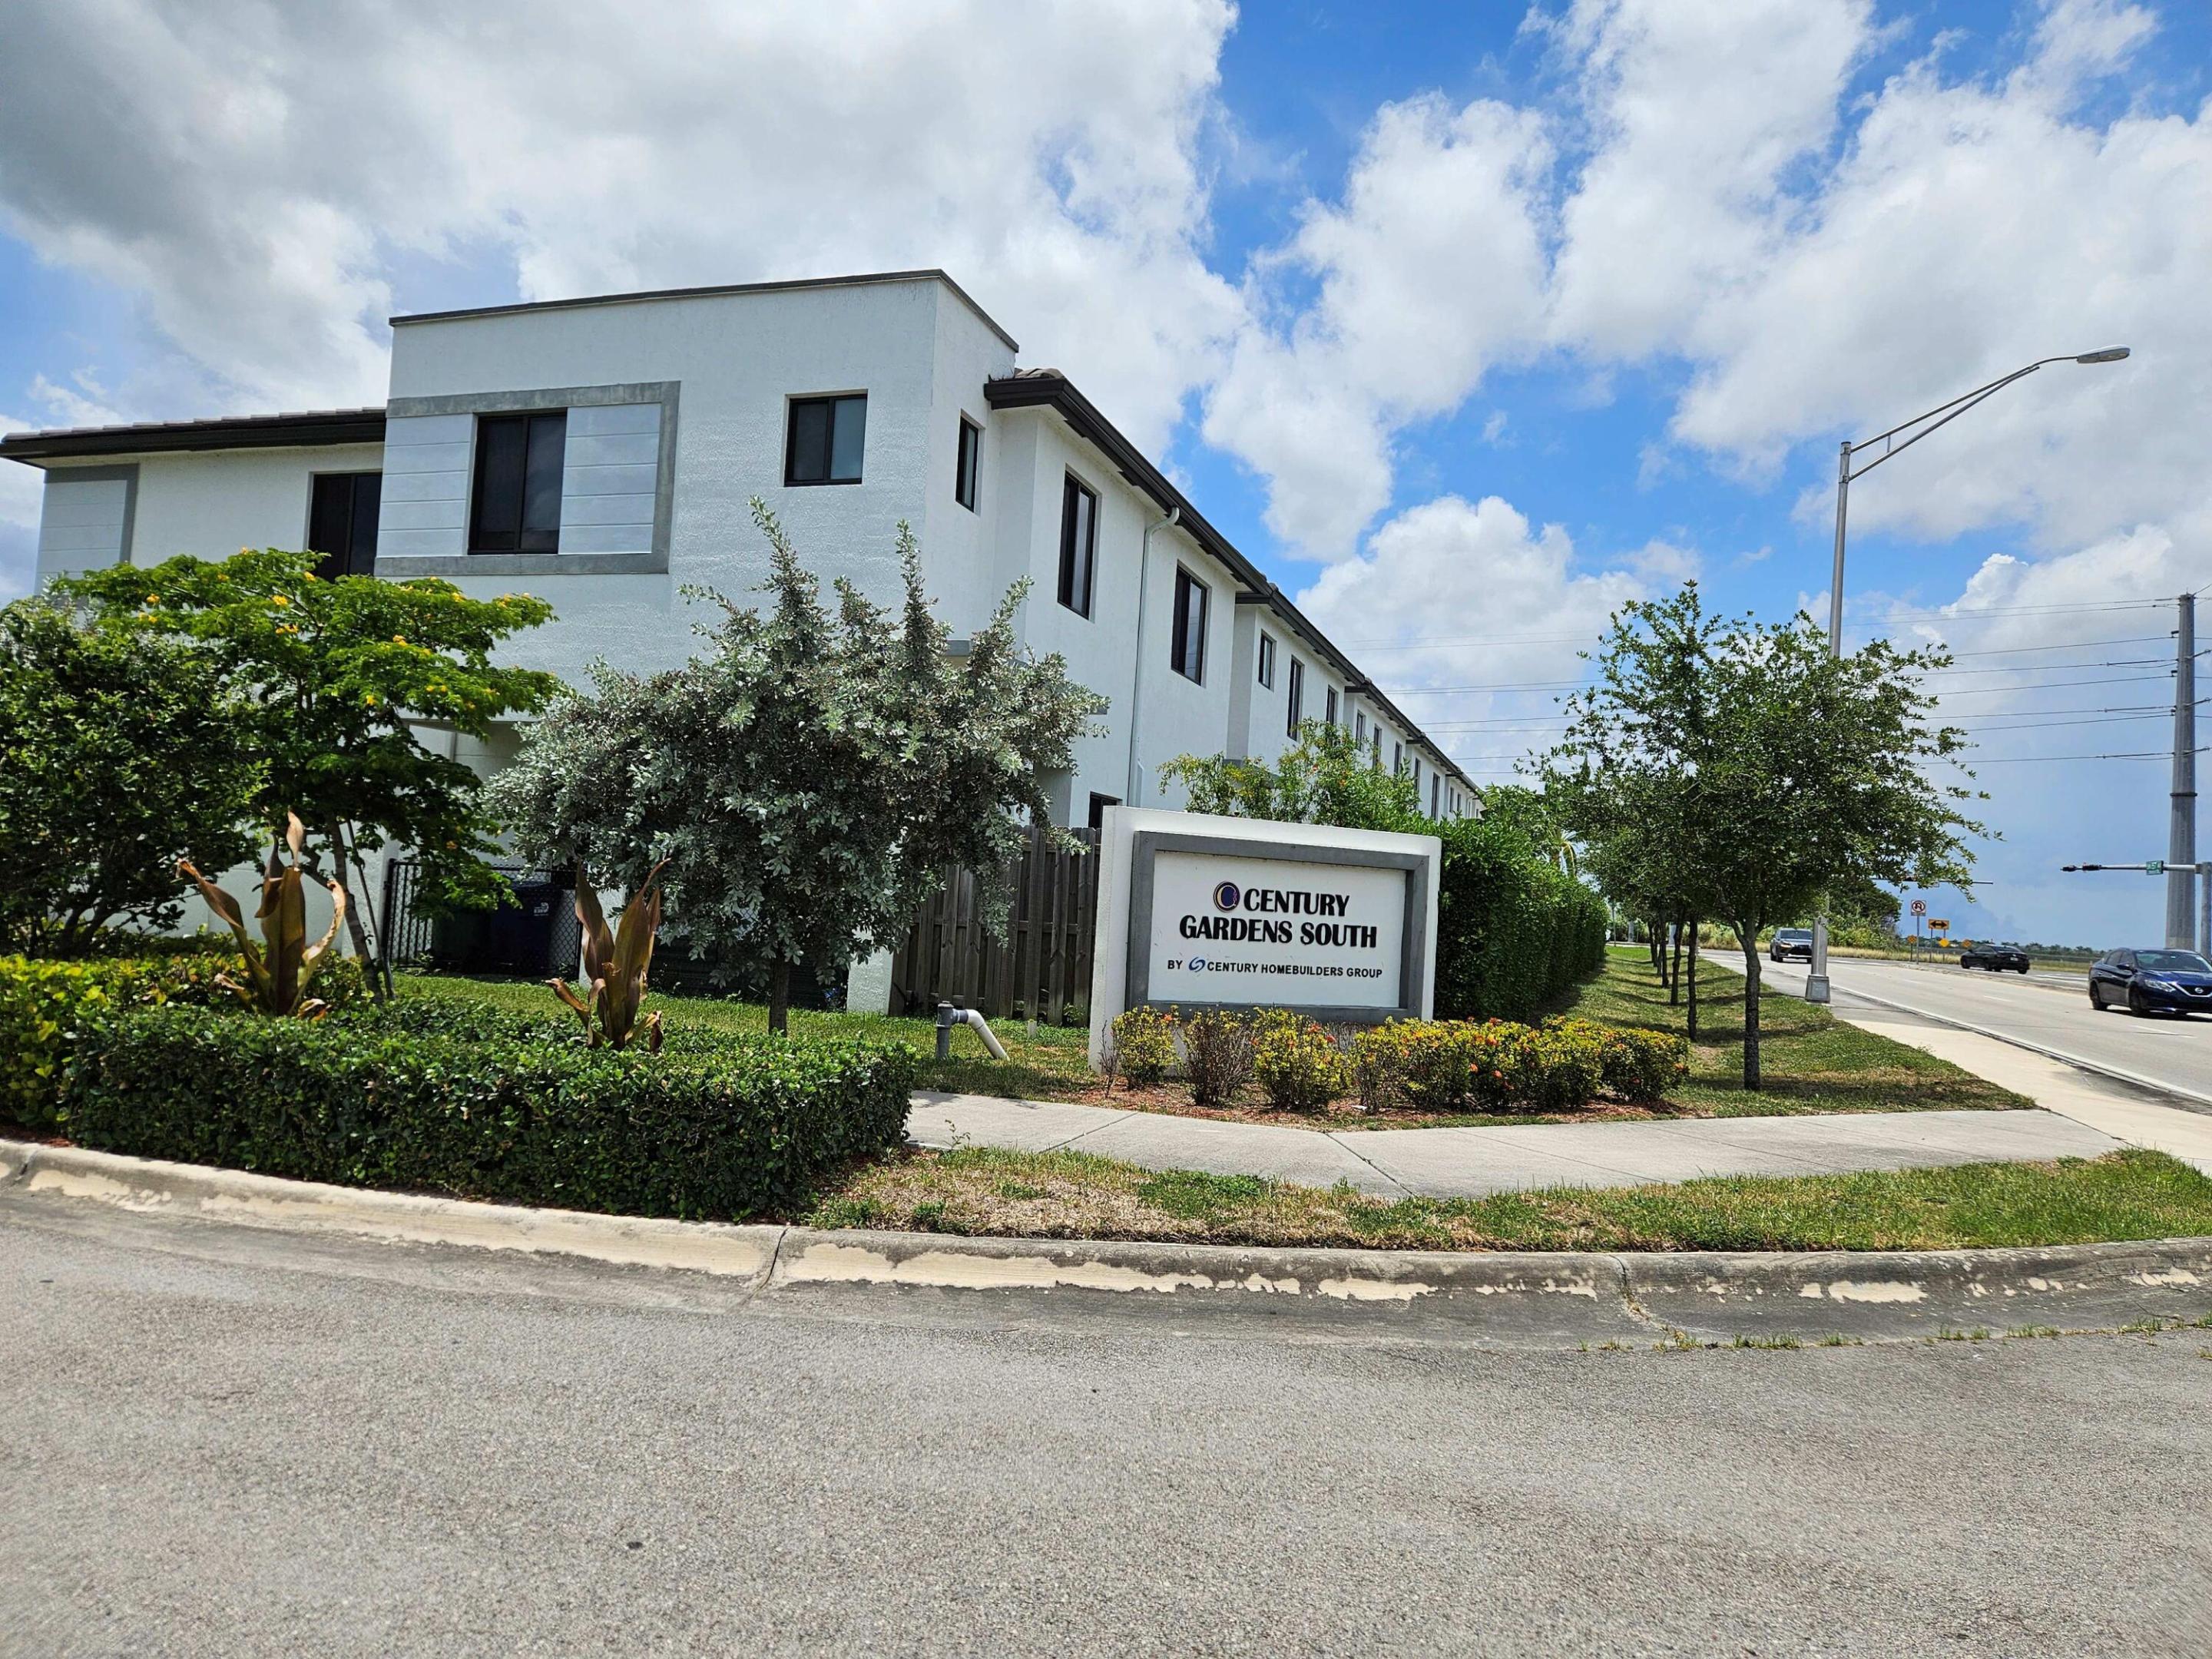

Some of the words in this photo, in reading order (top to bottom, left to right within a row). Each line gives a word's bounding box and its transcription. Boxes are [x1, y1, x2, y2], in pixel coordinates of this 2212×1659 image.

[1243, 888, 1350, 917] CENTURY
[1179, 914, 1293, 944] GARDENS
[1300, 922, 1377, 949] SOUTH
[1167, 959, 1183, 971] BY
[1207, 961, 1259, 974] CENTURY
[1260, 964, 1343, 977] HOMEBUILDERS
[1346, 967, 1383, 979] GROUP
